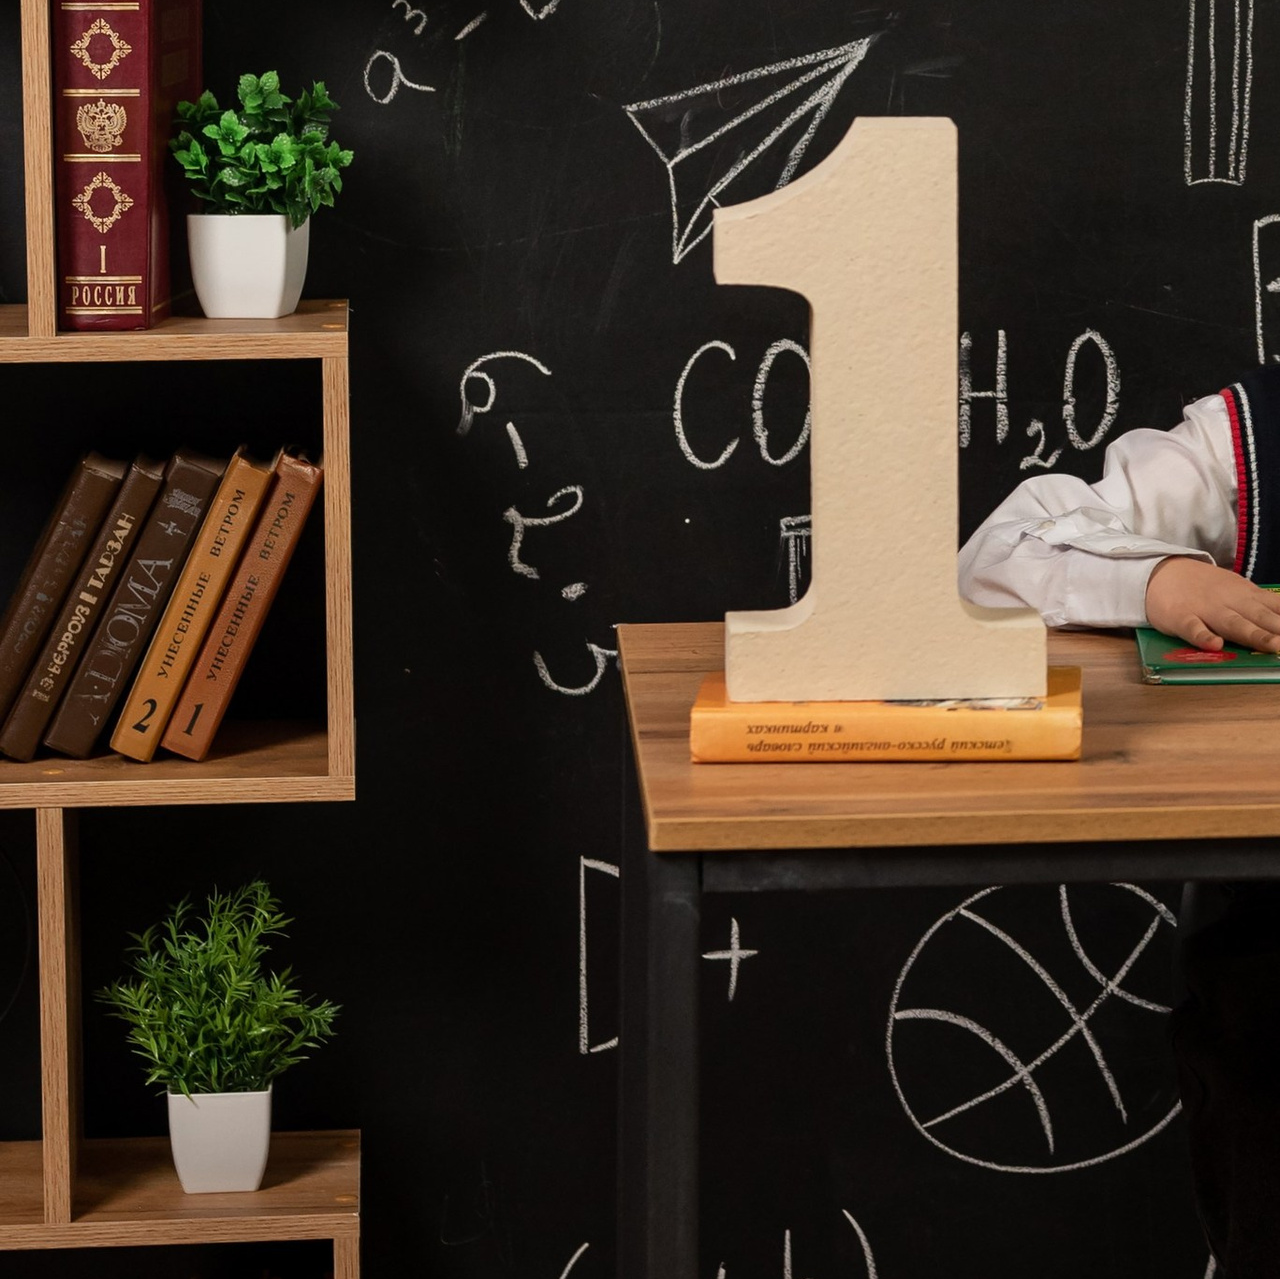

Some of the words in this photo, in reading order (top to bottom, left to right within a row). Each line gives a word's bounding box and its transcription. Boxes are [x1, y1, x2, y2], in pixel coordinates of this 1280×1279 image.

[71, 284, 137, 307] РОССИЯ
[86, 511, 136, 589] ТАРЗАН
[131, 698, 158, 734] 2
[157, 572, 211, 679] УНЕСЕННЫЕ
[209, 488, 246, 558] ВЕТРОМ
[182, 702, 204, 736] 1
[206, 574, 260, 682] УНЕСЕННЫЕ
[258, 491, 296, 561] ВЕТРОМ
[746, 722, 829, 734] картинках
[746, 740, 802, 752] словарь
[808, 738, 946, 755] русско-английский
